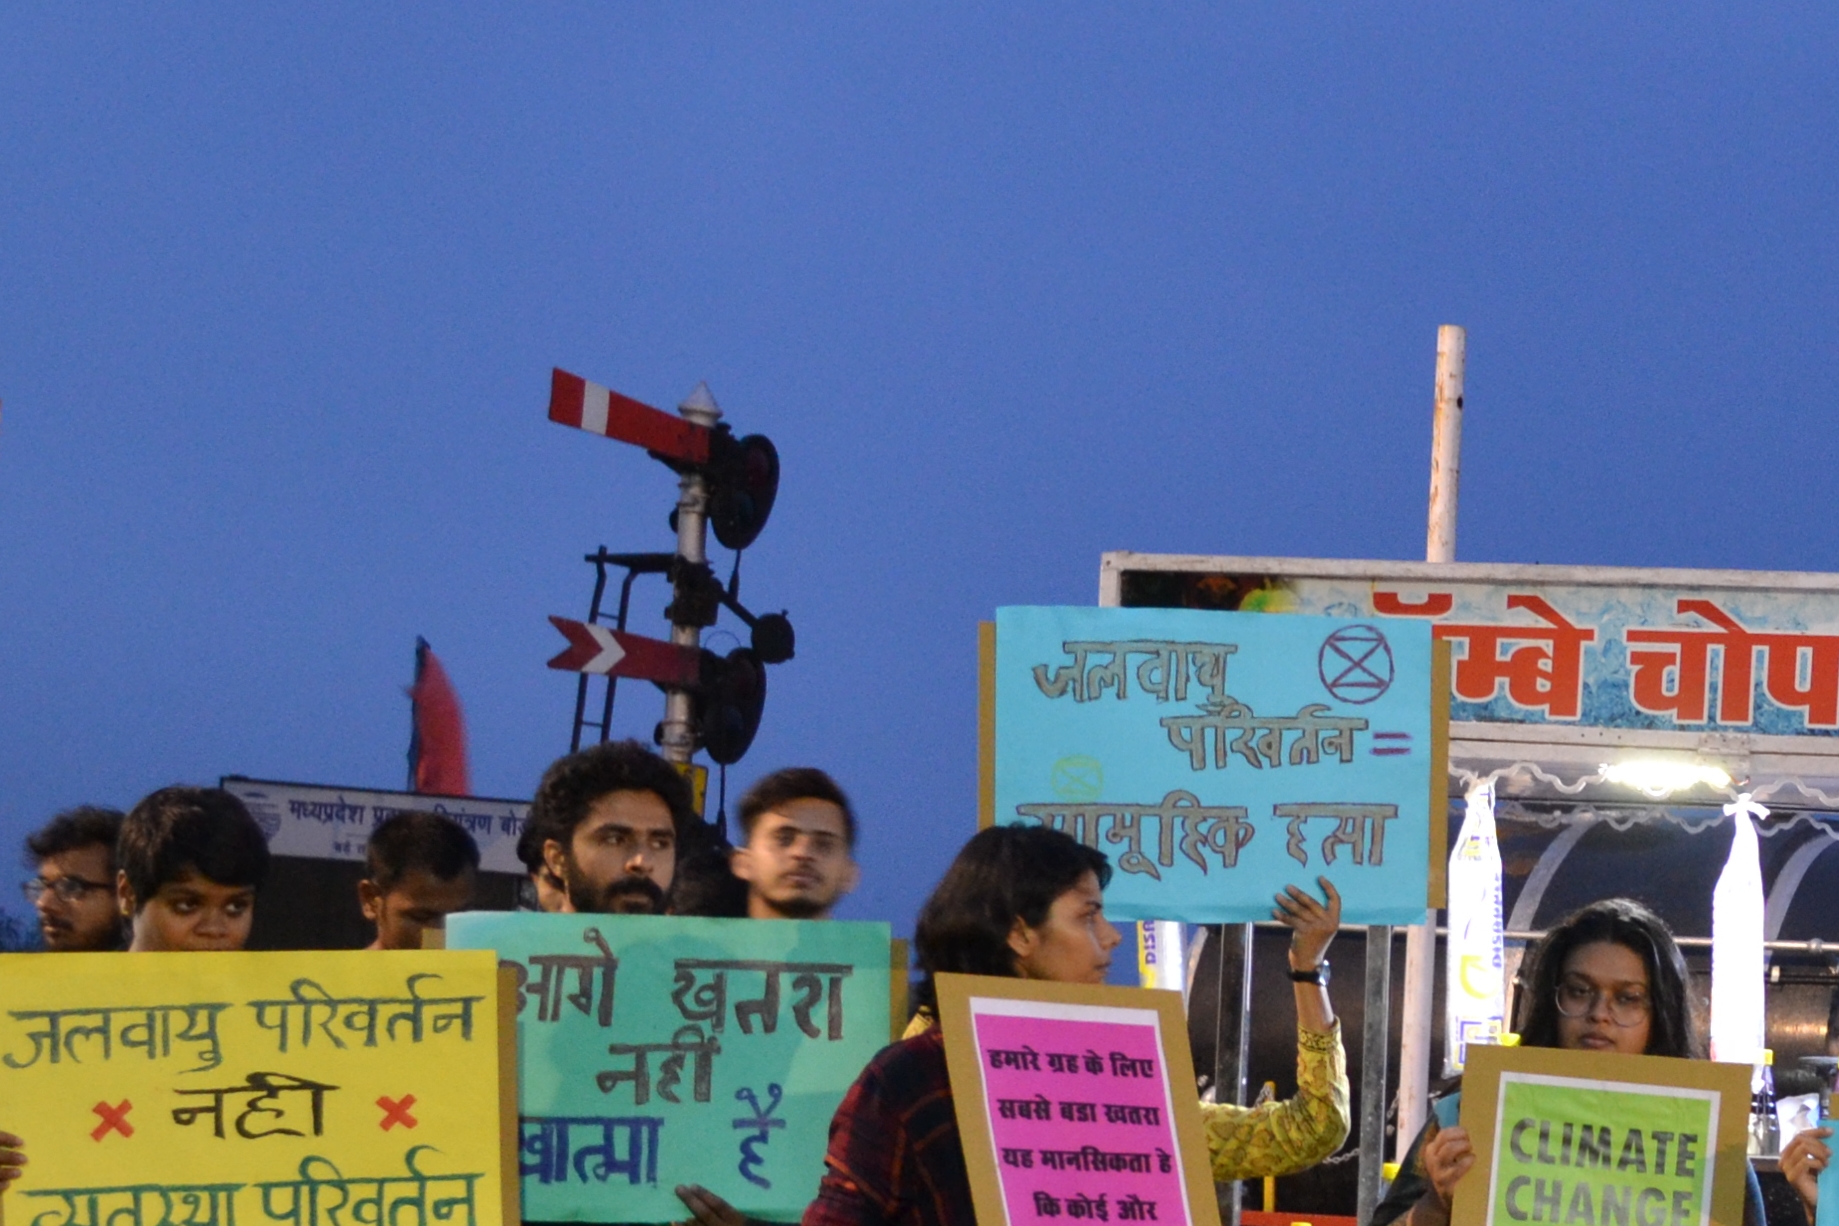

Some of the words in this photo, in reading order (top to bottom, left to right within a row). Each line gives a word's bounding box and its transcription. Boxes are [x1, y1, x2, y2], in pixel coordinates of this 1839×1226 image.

[1160, 703, 1368, 771] परिवर्तन
[670, 958, 854, 1041] खतरा
[2, 1002, 226, 1074] जलवायु
[248, 974, 485, 1053] परिवर्तन
[989, 1045, 1041, 1071] हमारे
[1046, 1052, 1079, 1073] ग्रह
[1083, 1049, 1103, 1075] के
[1109, 1052, 1153, 1078] लिए
[997, 1094, 1053, 1120] सबसे
[1103, 1104, 1160, 1126] खतरा
[1000, 1148, 1033, 1168] यह
[1039, 1146, 1152, 1172] मानसिकता
[1510, 1118, 1697, 1177] CLIMATE
[1033, 1191, 1060, 1217] कि
[1066, 1193, 1109, 1222] कोई
[1116, 1194, 1158, 1220] और
